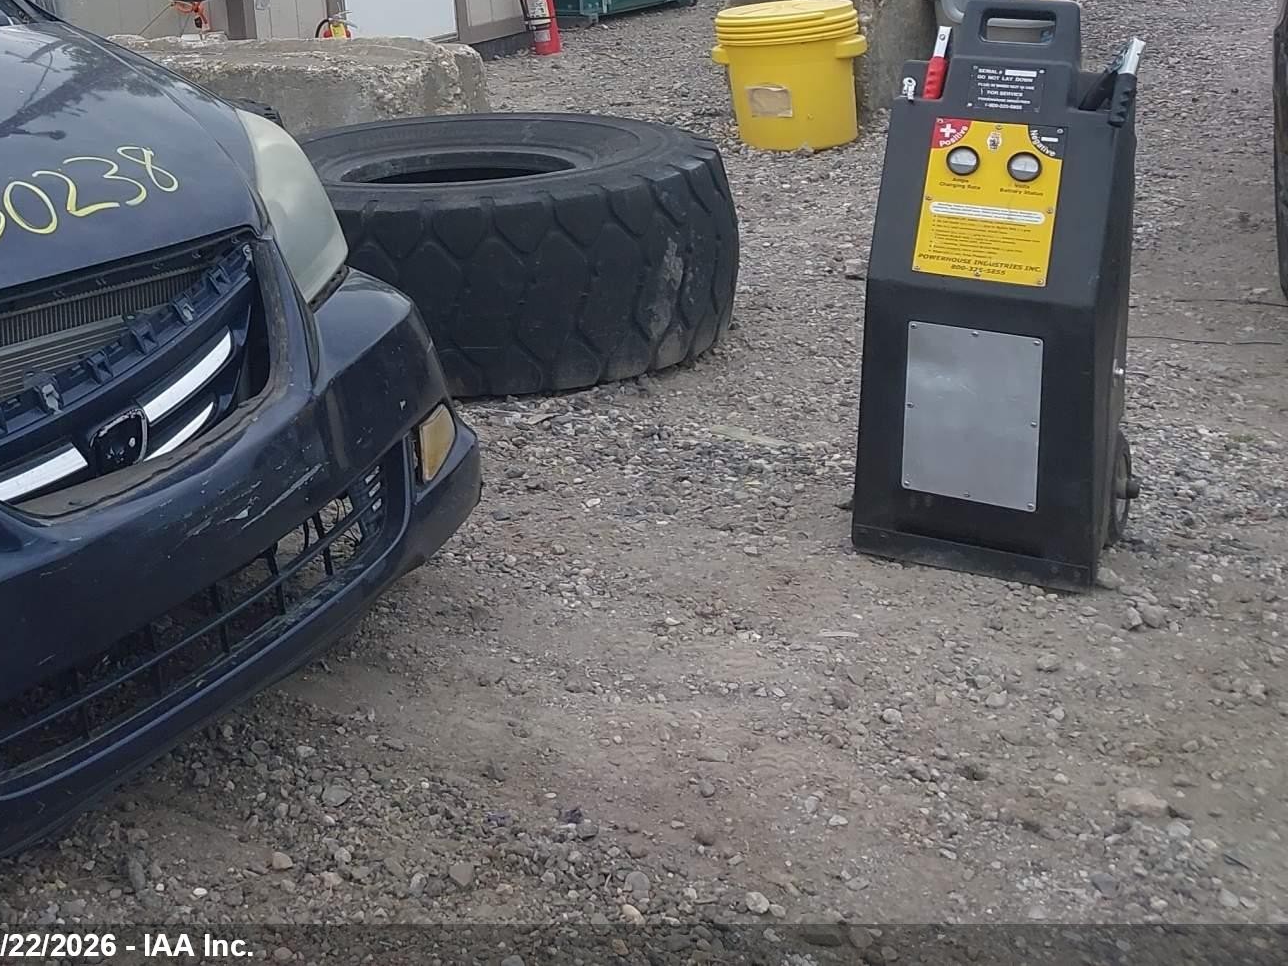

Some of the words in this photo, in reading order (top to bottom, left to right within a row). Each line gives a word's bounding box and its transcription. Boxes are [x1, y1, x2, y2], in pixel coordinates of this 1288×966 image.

[939, 125, 969, 148] Positive
[1030, 129, 1056, 157] Negative
[918, 253, 971, 265] POWERHOUSE
[974, 259, 1023, 271] INDUSTRIES
